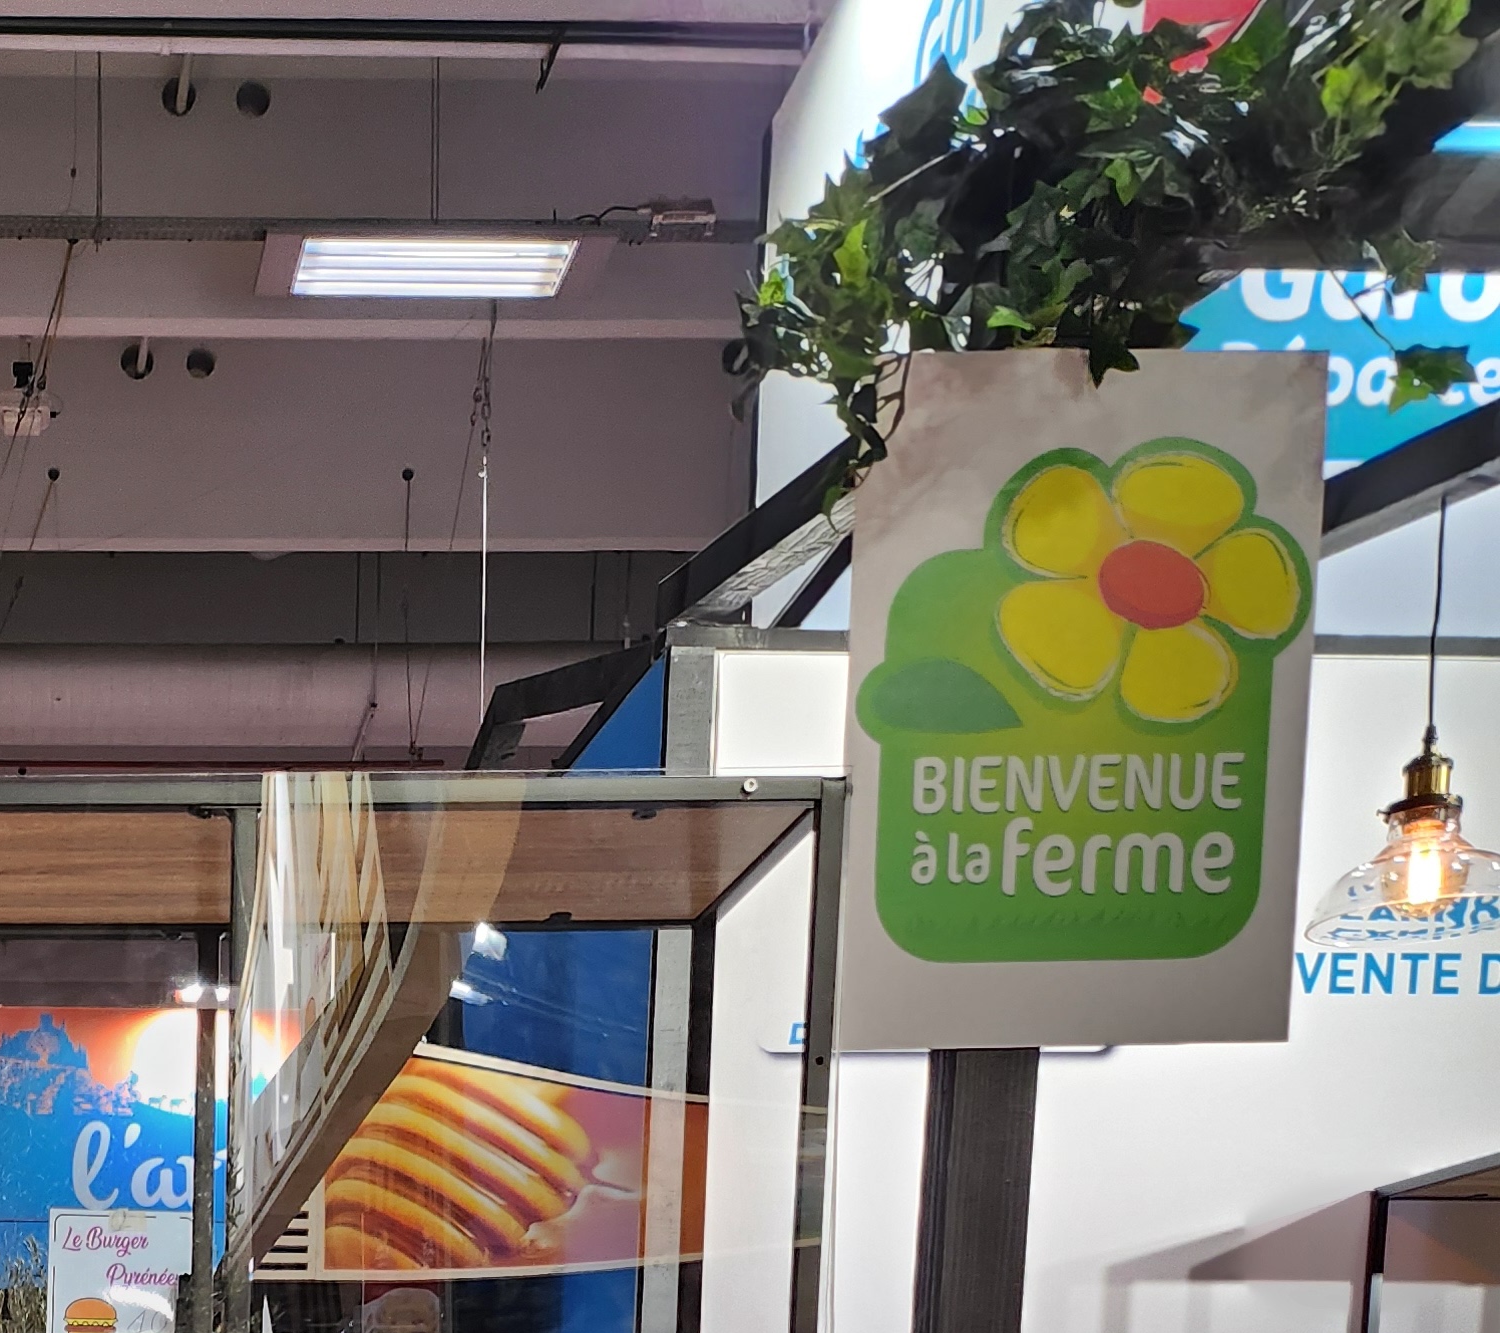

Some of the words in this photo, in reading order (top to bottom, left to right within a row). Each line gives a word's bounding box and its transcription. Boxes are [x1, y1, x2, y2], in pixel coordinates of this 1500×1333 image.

[912, 752, 1246, 814] BIENVENUE
[910, 830, 938, 886] à
[946, 832, 992, 885] la
[1001, 816, 1236, 897] ferme
[1295, 952, 1462, 995] VENTE
[62, 1226, 83, 1252] Le
[85, 1226, 149, 1257] Burger
